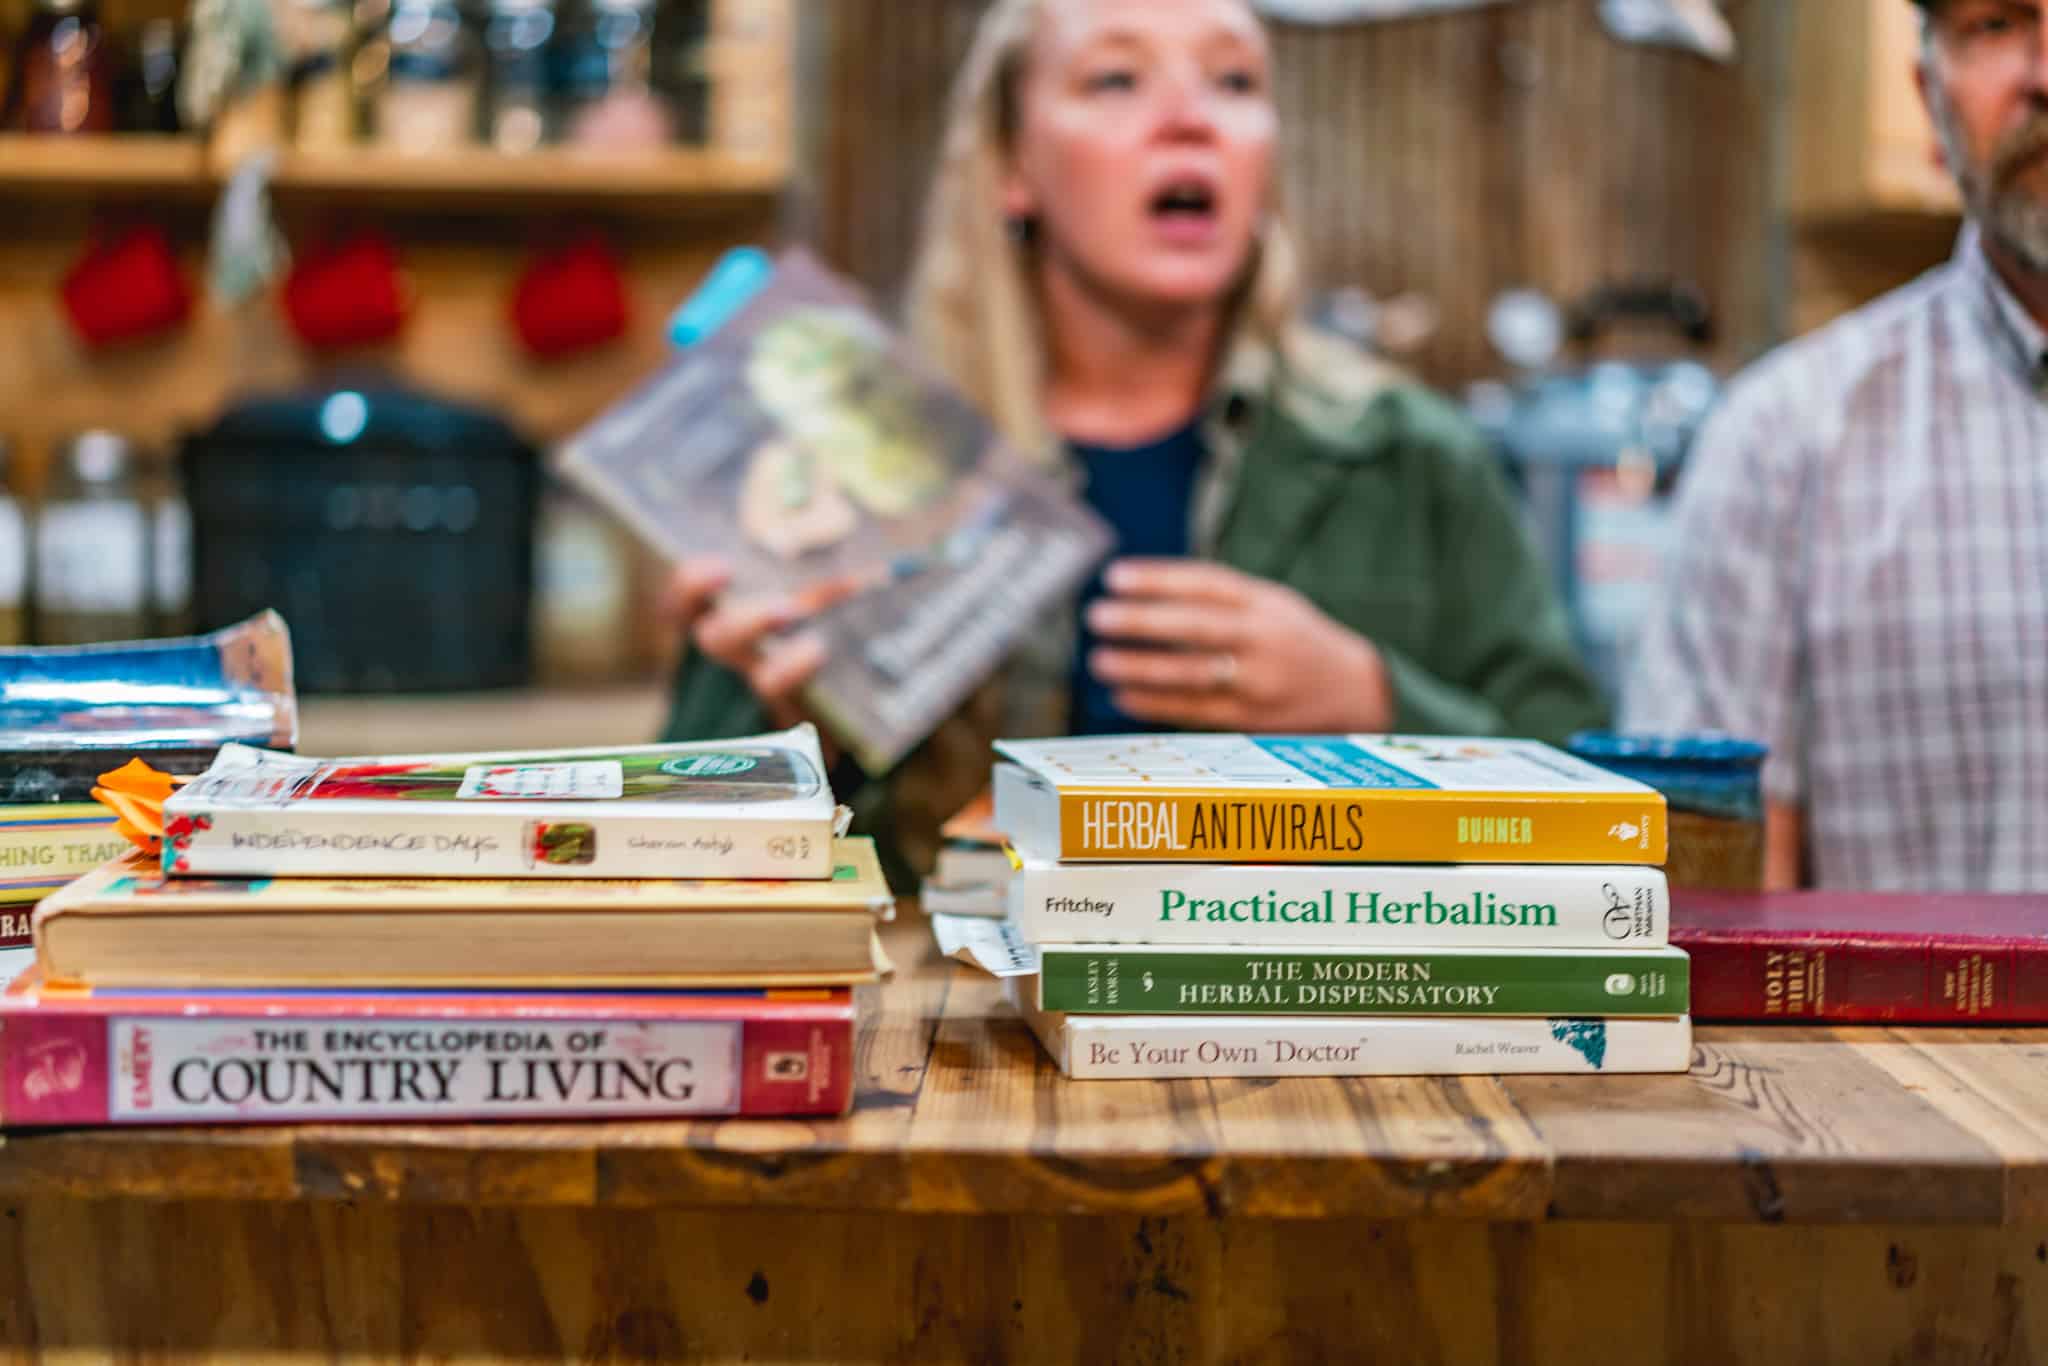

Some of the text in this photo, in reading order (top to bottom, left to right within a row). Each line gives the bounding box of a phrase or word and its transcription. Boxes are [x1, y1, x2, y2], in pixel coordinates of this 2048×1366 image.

[1082, 801, 1364, 851] HERBAL ANTIVIRALS
[1457, 817, 1533, 844] BUHNER
[232, 831, 499, 863] INDEPENDENCE DAYS
[1045, 897, 1114, 917] Fritchey
[1160, 889, 1557, 926] Practical Herbalism
[0, 913, 33, 937] RA
[1247, 962, 1431, 981] THE MODERN
[1180, 985, 1499, 1004] HERBAL DISPENSATORY
[254, 1030, 606, 1052] THE ENCYCLOPEDIA OF
[1455, 1042, 1498, 1056] Rachel
[1089, 1043, 1120, 1064] Be
[1130, 1043, 1189, 1064] Your
[1198, 1042, 1257, 1064] Own
[172, 1059, 460, 1103] COUNTRY
[487, 1058, 694, 1101] LIVING
